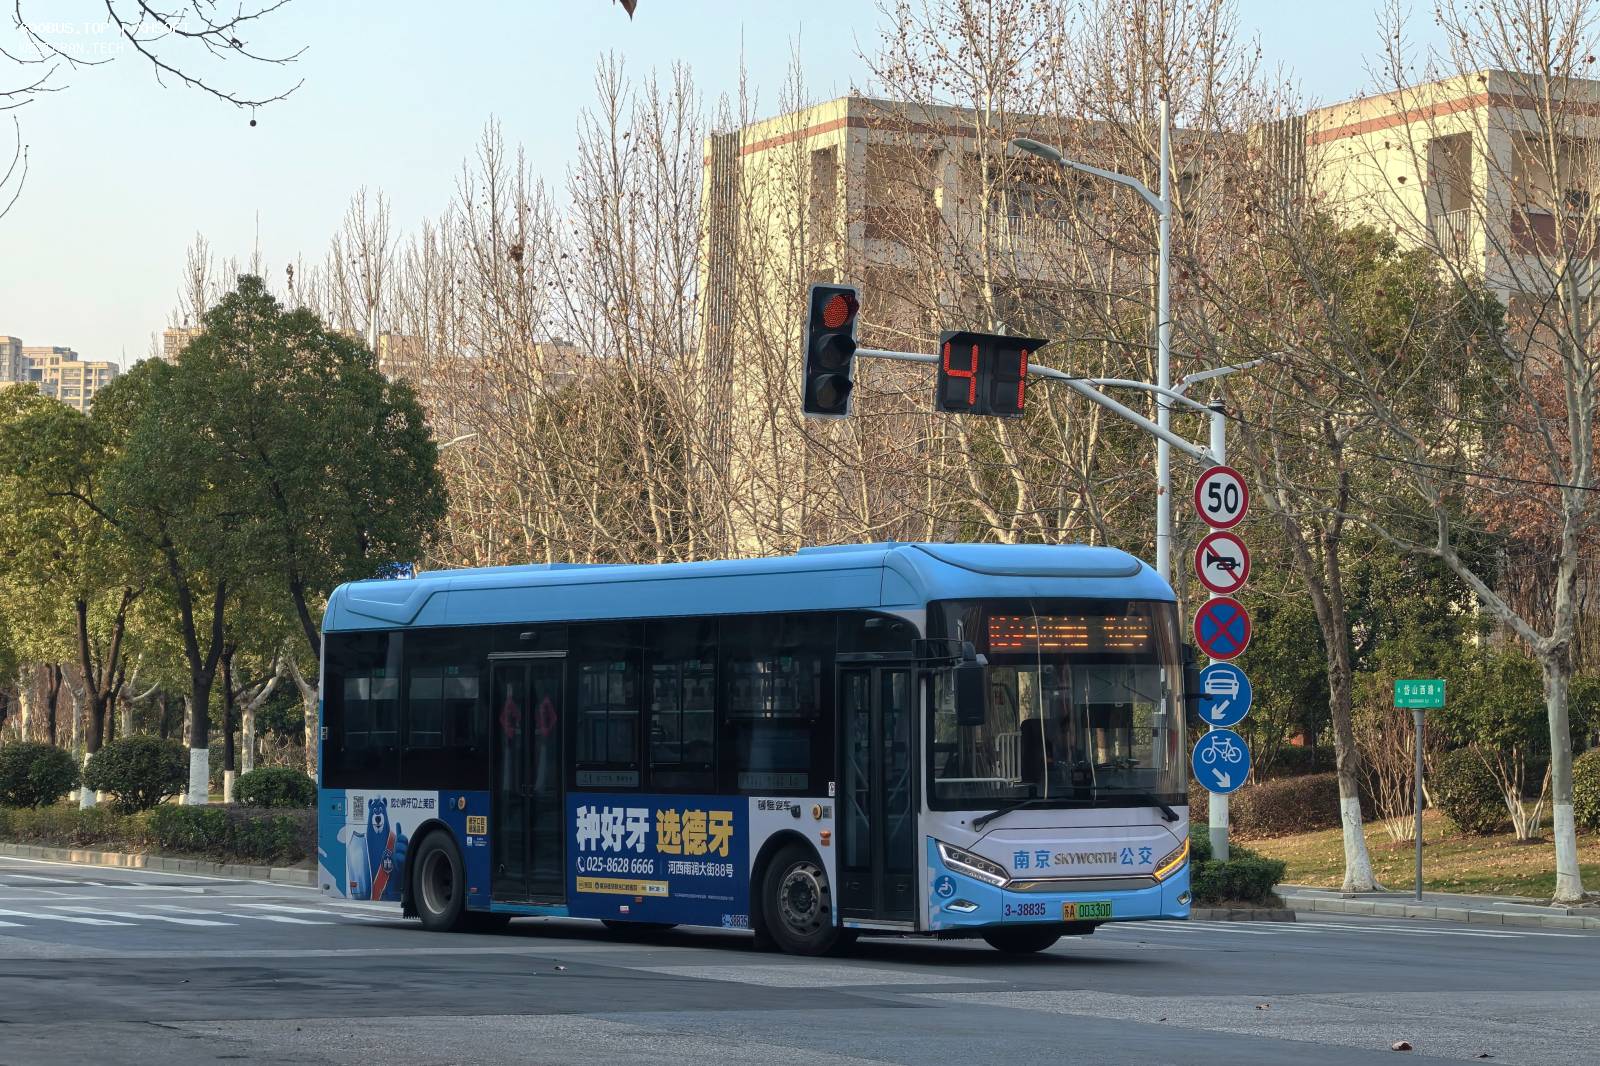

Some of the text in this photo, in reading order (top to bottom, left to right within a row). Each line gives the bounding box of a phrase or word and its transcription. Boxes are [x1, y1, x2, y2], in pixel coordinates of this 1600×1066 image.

[943, 341, 1028, 410] 41
[1207, 482, 1239, 514] 50
[576, 805, 734, 858] 种好牙 选德牙
[586, 856, 654, 874] 025-8628 6666
[668, 860, 734, 878] 河西雨润大街88号
[1013, 846, 1153, 869] 南京 SKYWORTH 公交
[1004, 902, 1046, 917] 3-38835
